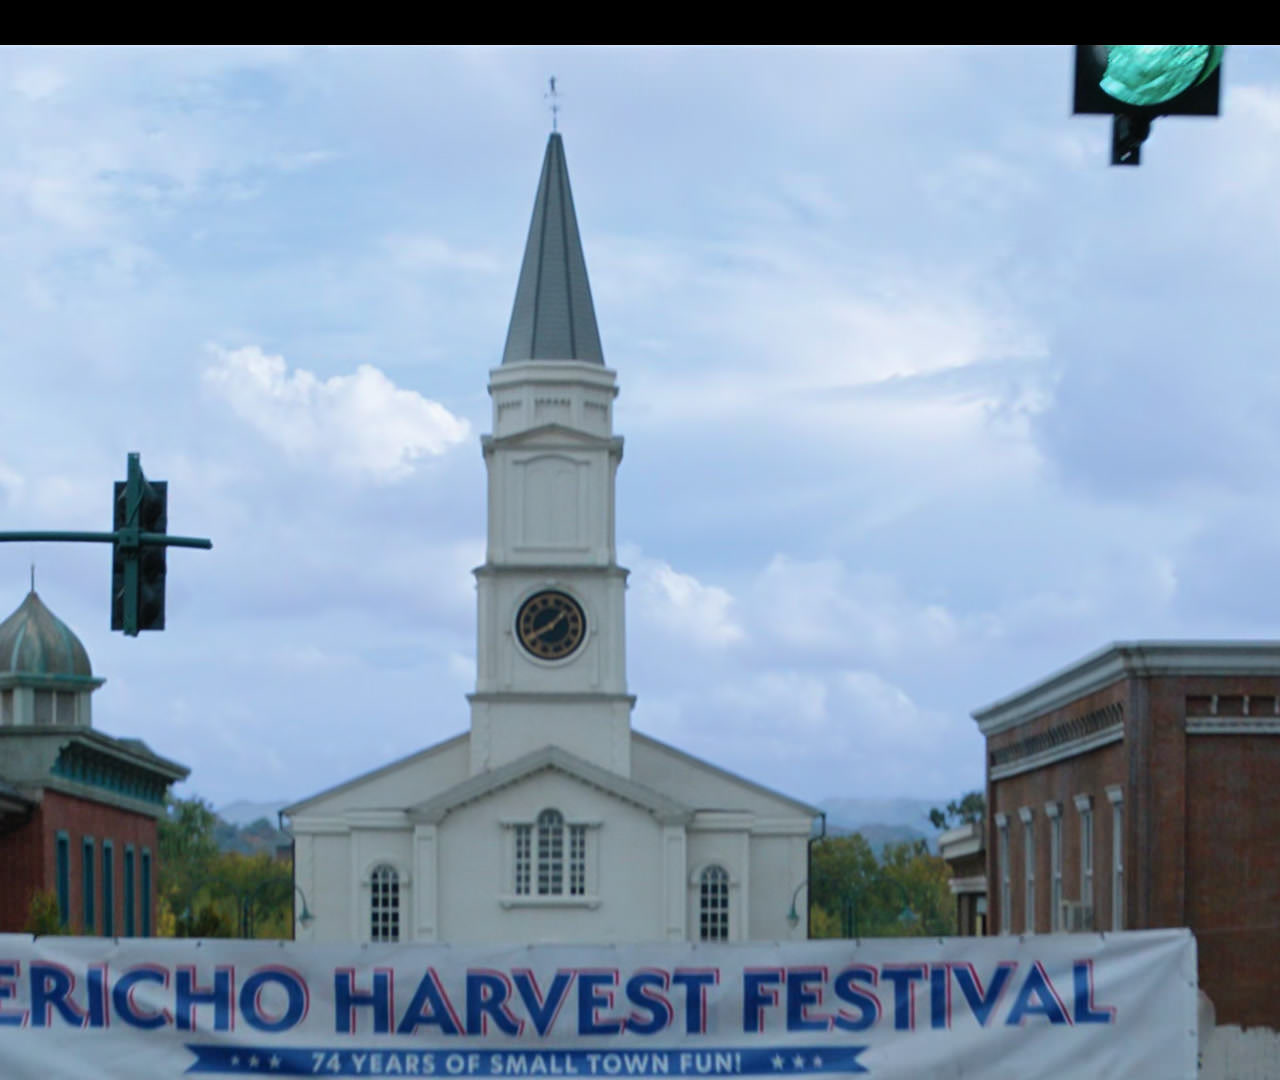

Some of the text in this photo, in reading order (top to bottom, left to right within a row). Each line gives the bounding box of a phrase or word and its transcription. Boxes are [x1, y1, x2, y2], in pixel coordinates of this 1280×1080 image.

[334, 965, 720, 1037] HARVEST
[742, 958, 1117, 1034] FESTIVAL
[312, 1051, 742, 1075] 74 YEARS OF SMALL TOWN FUN!
